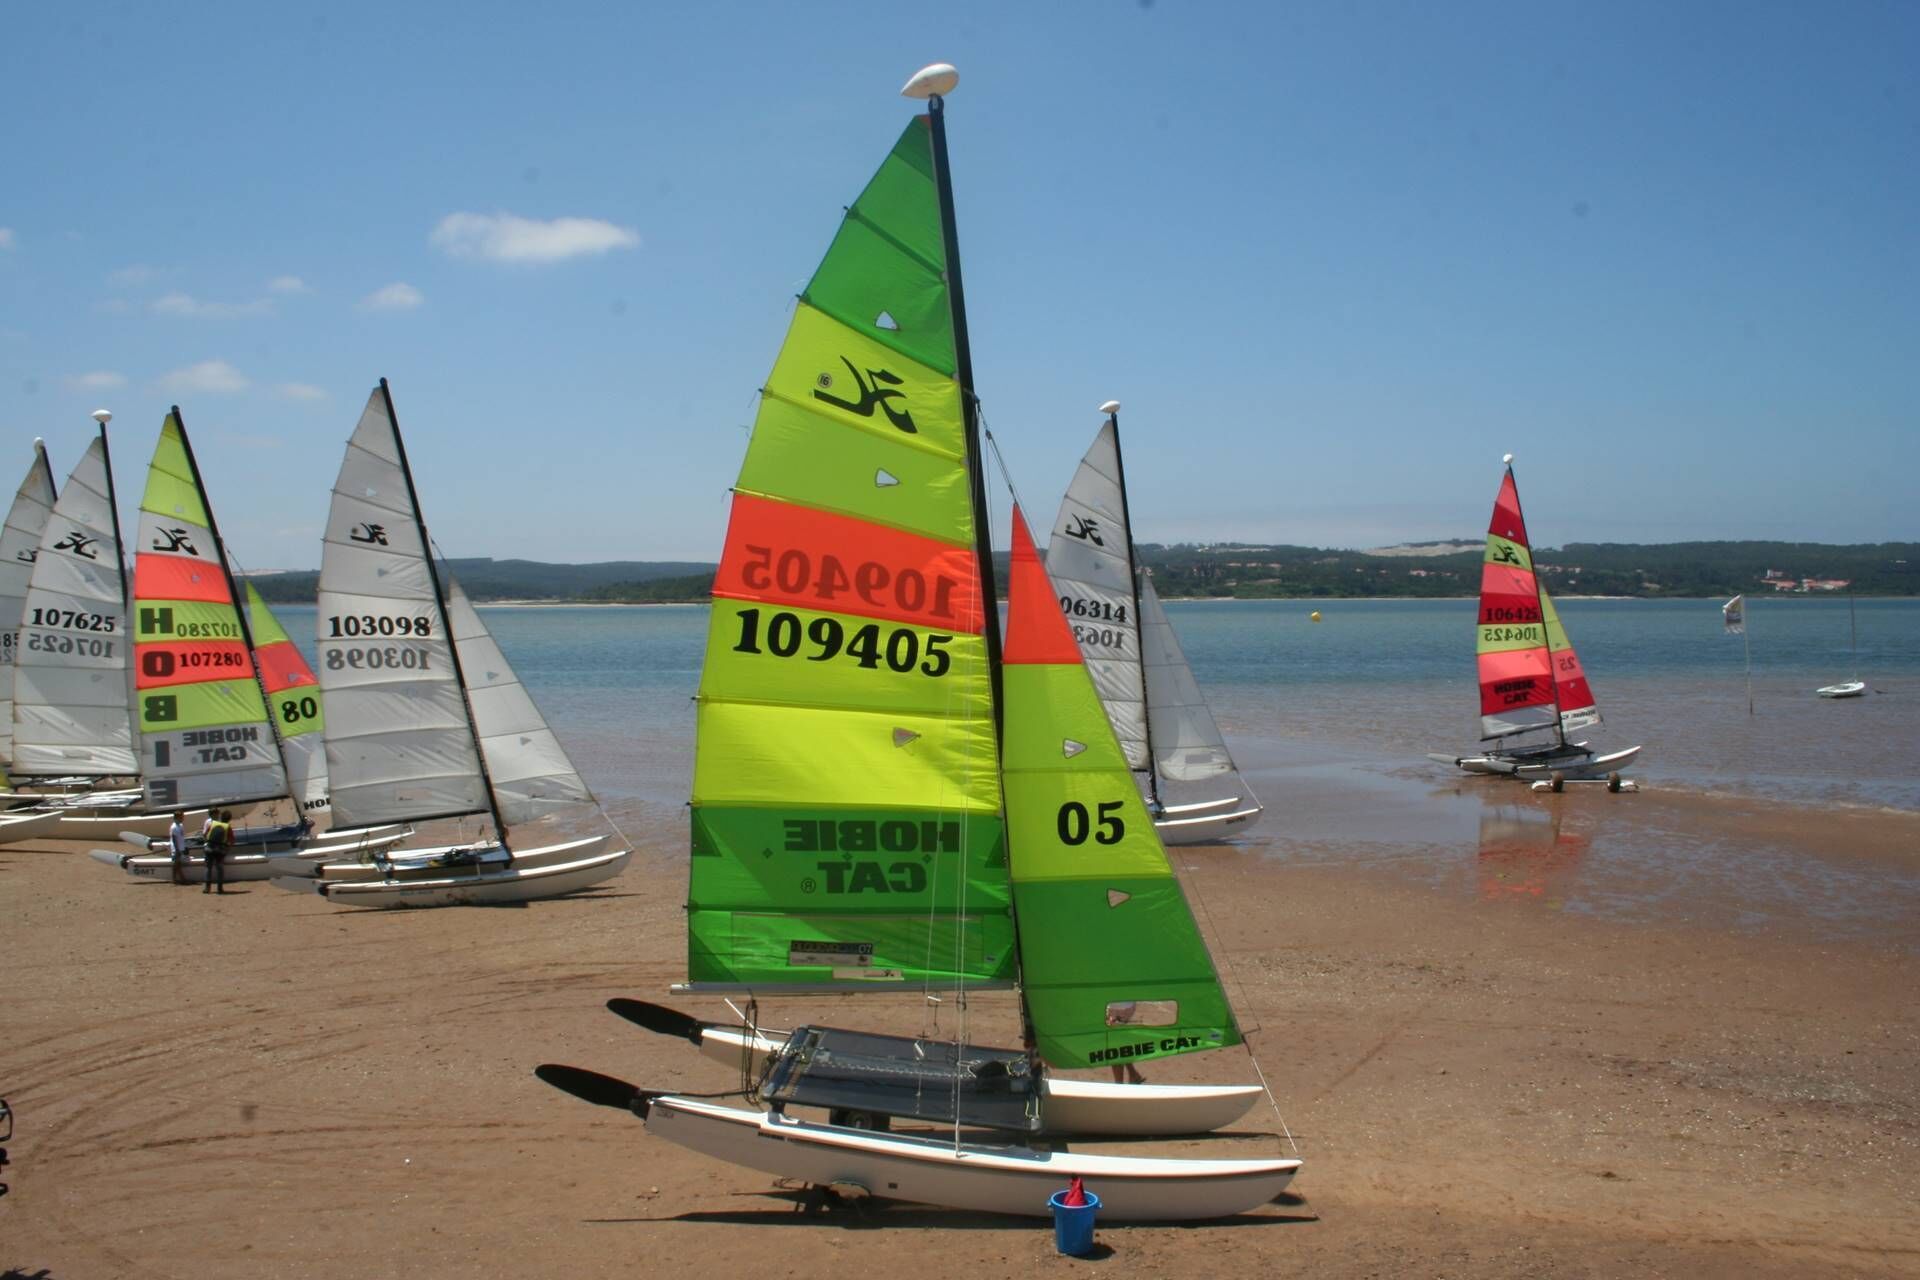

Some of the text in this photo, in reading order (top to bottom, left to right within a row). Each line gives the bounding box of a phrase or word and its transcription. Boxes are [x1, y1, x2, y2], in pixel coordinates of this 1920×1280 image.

[31, 607, 116, 632] 107625
[328, 615, 431, 637] 103098
[1486, 607, 1538, 621] 106425
[732, 608, 954, 677] 109405
[180, 652, 244, 667] 107280
[281, 696, 318, 724] 80
[1057, 801, 1125, 846] 05
[1088, 1036, 1201, 1064] HOBIE CAT
